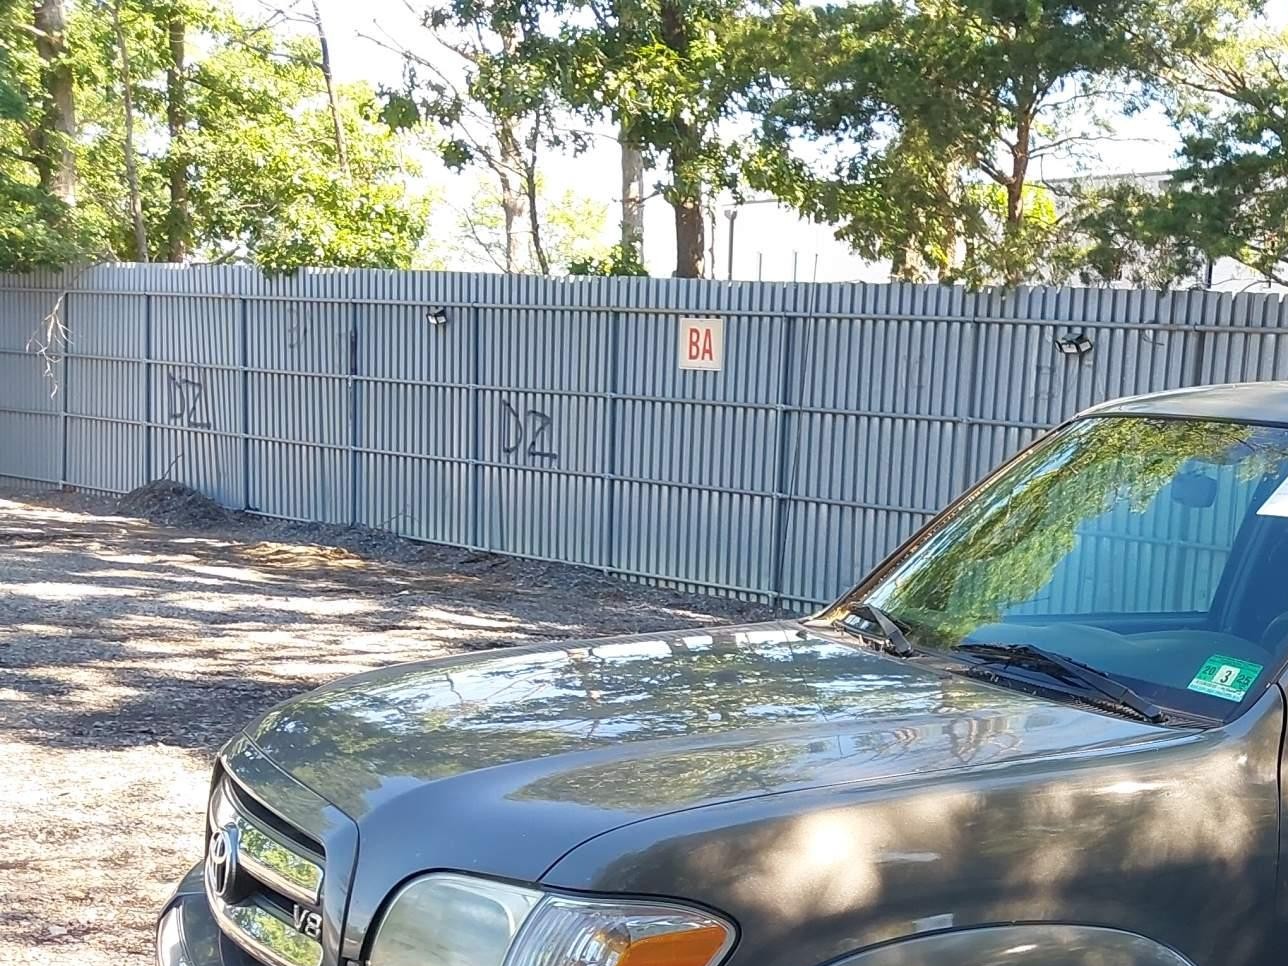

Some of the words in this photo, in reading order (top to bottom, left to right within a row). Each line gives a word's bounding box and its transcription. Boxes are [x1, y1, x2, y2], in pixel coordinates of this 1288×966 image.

[688, 327, 714, 361] BA
[1203, 665, 1217, 676] 20
[1220, 670, 1233, 683] 3
[293, 903, 323, 939] V8
